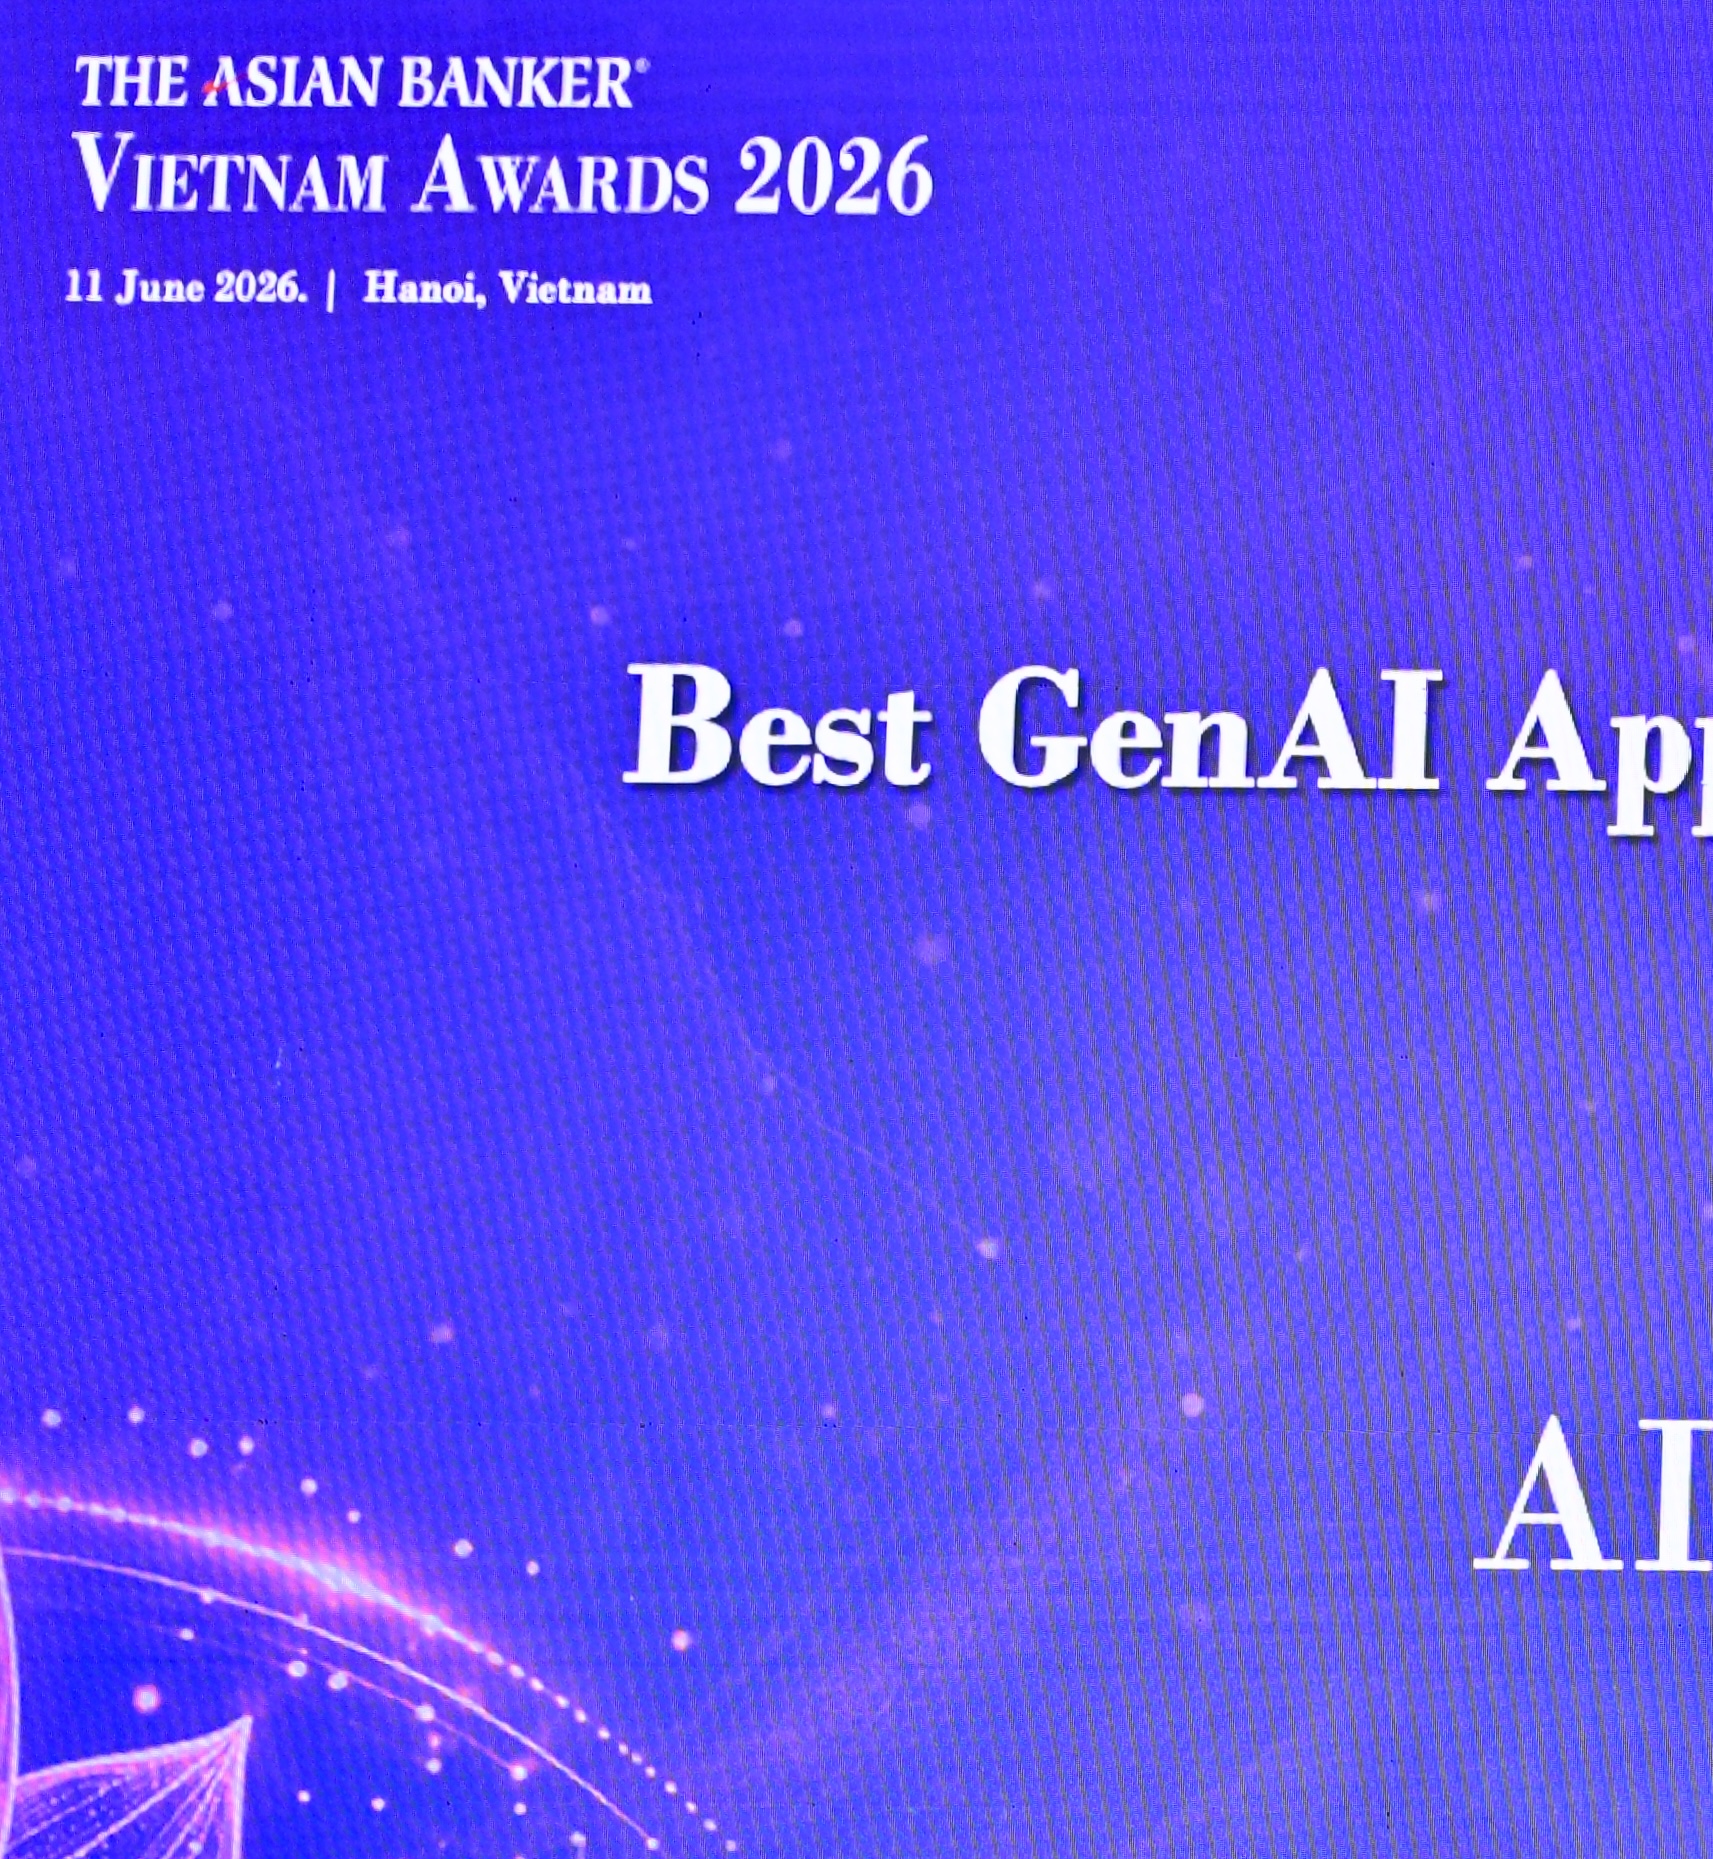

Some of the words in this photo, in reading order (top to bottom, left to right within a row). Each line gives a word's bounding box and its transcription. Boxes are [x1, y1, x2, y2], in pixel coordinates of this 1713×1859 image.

[75, 55, 188, 108] THE
[203, 55, 384, 108] ASIAN
[734, 135, 934, 217] 2026
[65, 268, 102, 303] 11
[115, 268, 205, 306] June
[213, 269, 308, 304] 2026.
[363, 271, 487, 309] Hanoi,
[498, 269, 653, 305] Vietnam
[621, 662, 934, 789] Best
[977, 664, 1444, 791] GenAI
